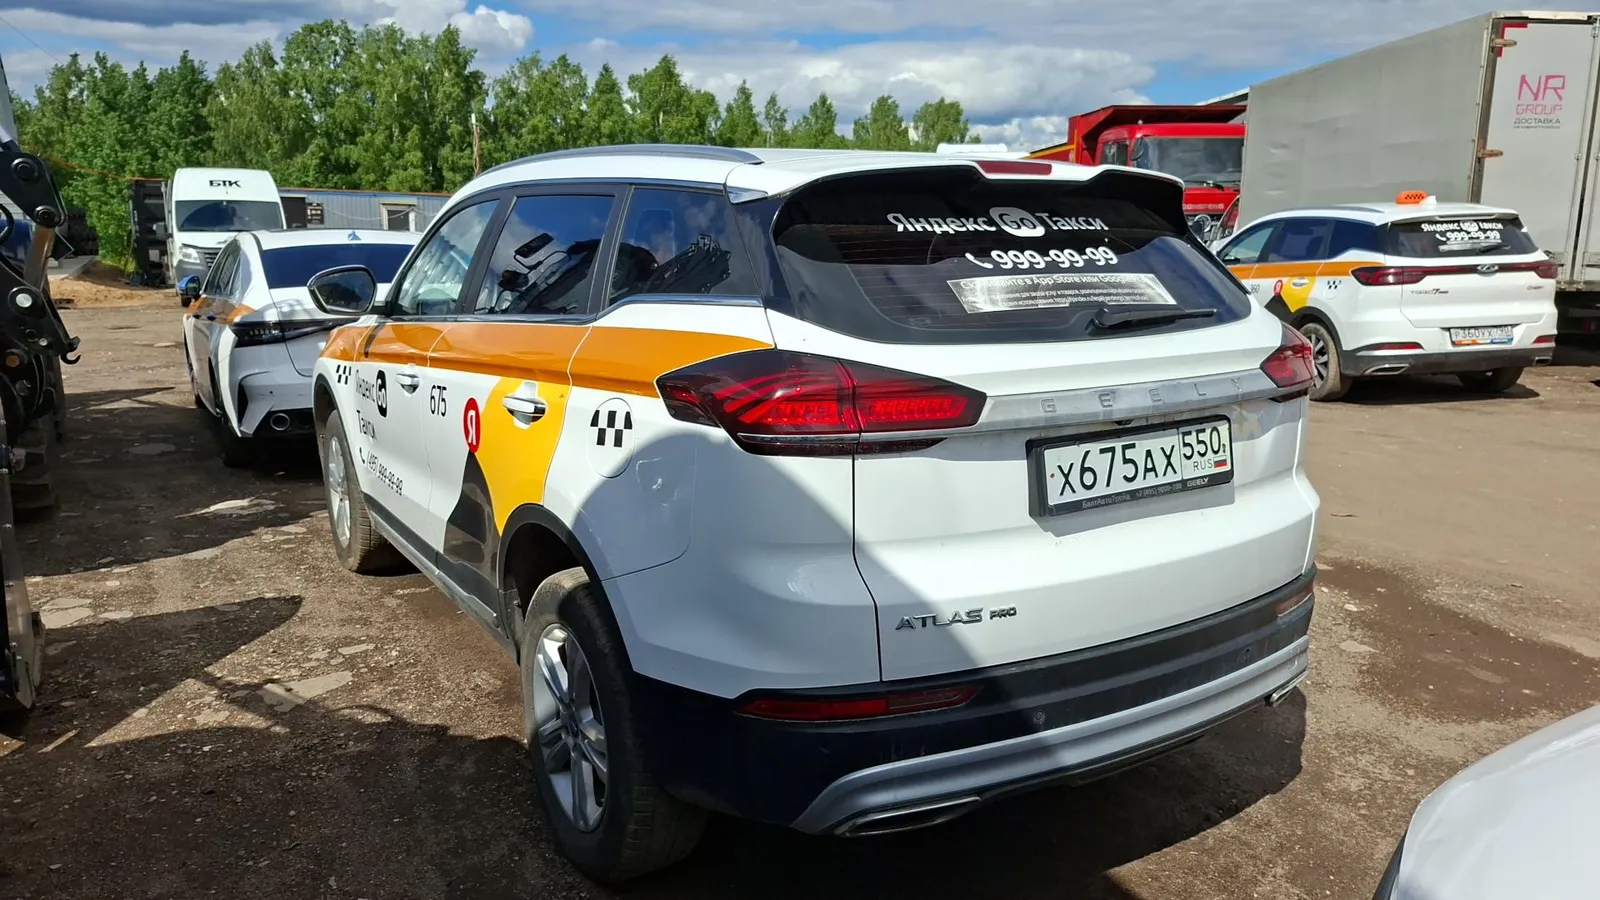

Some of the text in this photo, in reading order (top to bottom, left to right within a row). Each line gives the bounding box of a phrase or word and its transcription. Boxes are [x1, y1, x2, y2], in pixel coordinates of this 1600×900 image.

[1518, 74, 1566, 101] NR
[1514, 117, 1561, 125] ДОСТАВКА
[1516, 104, 1563, 115] GROUP
[208, 179, 242, 188] БТК
[886, 211, 1110, 234] Яндекс Go Такси
[1446, 230, 1500, 241] 999-99-99
[990, 246, 1119, 270] 999-99-99
[1033, 275, 1054, 287] App
[1053, 274, 1081, 284] Store
[377, 377, 387, 410] Go
[430, 384, 447, 417] 675
[1041, 377, 1242, 414] GEELY
[467, 409, 477, 446] Я
[1181, 426, 1221, 460] 550
[1193, 459, 1213, 471] RUS
[1187, 477, 1209, 487] GEELY
[895, 606, 1017, 631] ATLAS PRO
